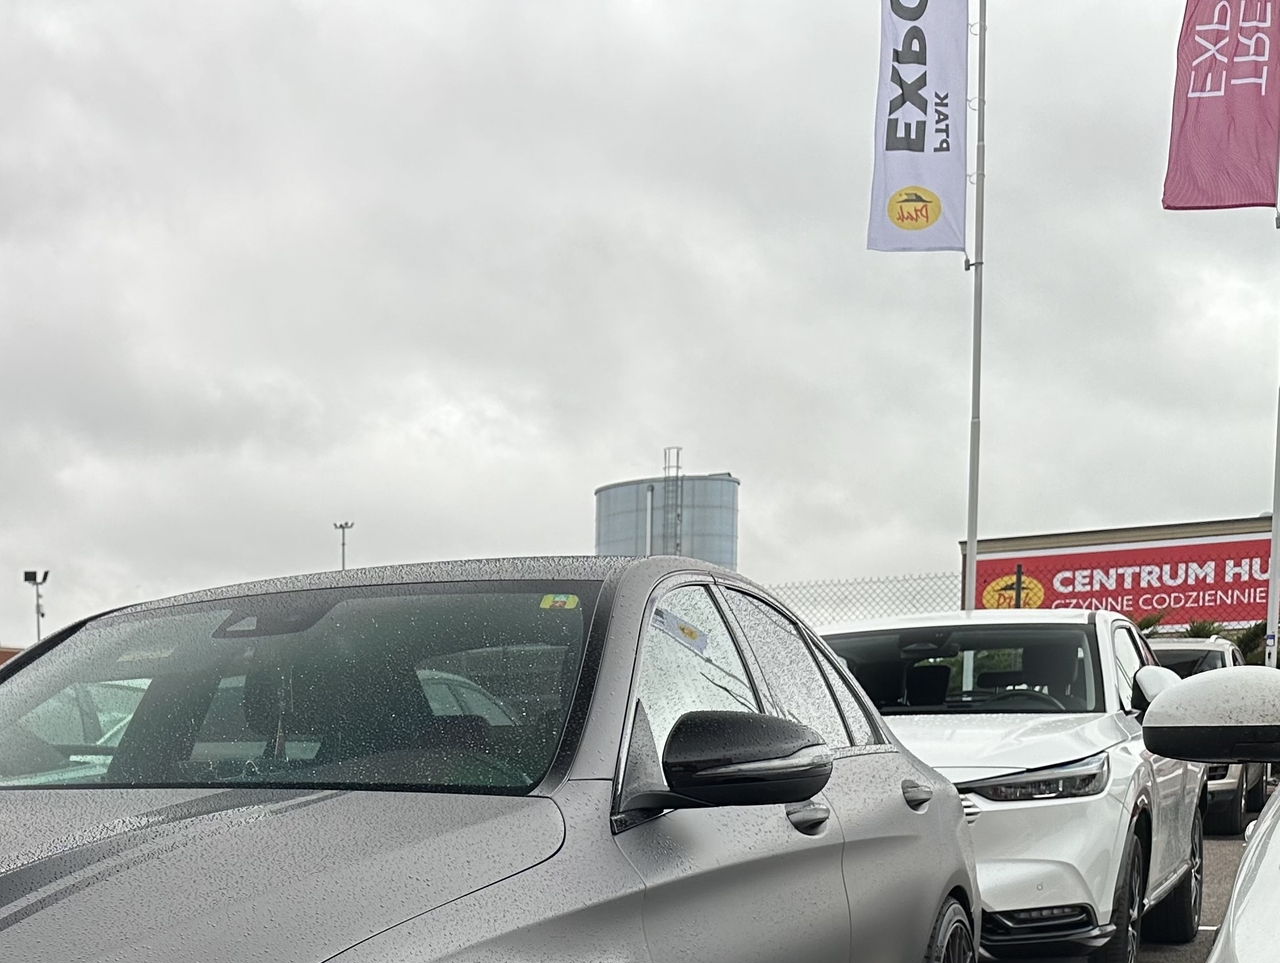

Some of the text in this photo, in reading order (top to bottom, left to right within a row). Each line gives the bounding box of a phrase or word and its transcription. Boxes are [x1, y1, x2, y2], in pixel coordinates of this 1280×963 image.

[1052, 560, 1216, 594] CENTRUM
[996, 592, 1031, 609] Ptk
[1138, 587, 1268, 610] CODZIENNIE
